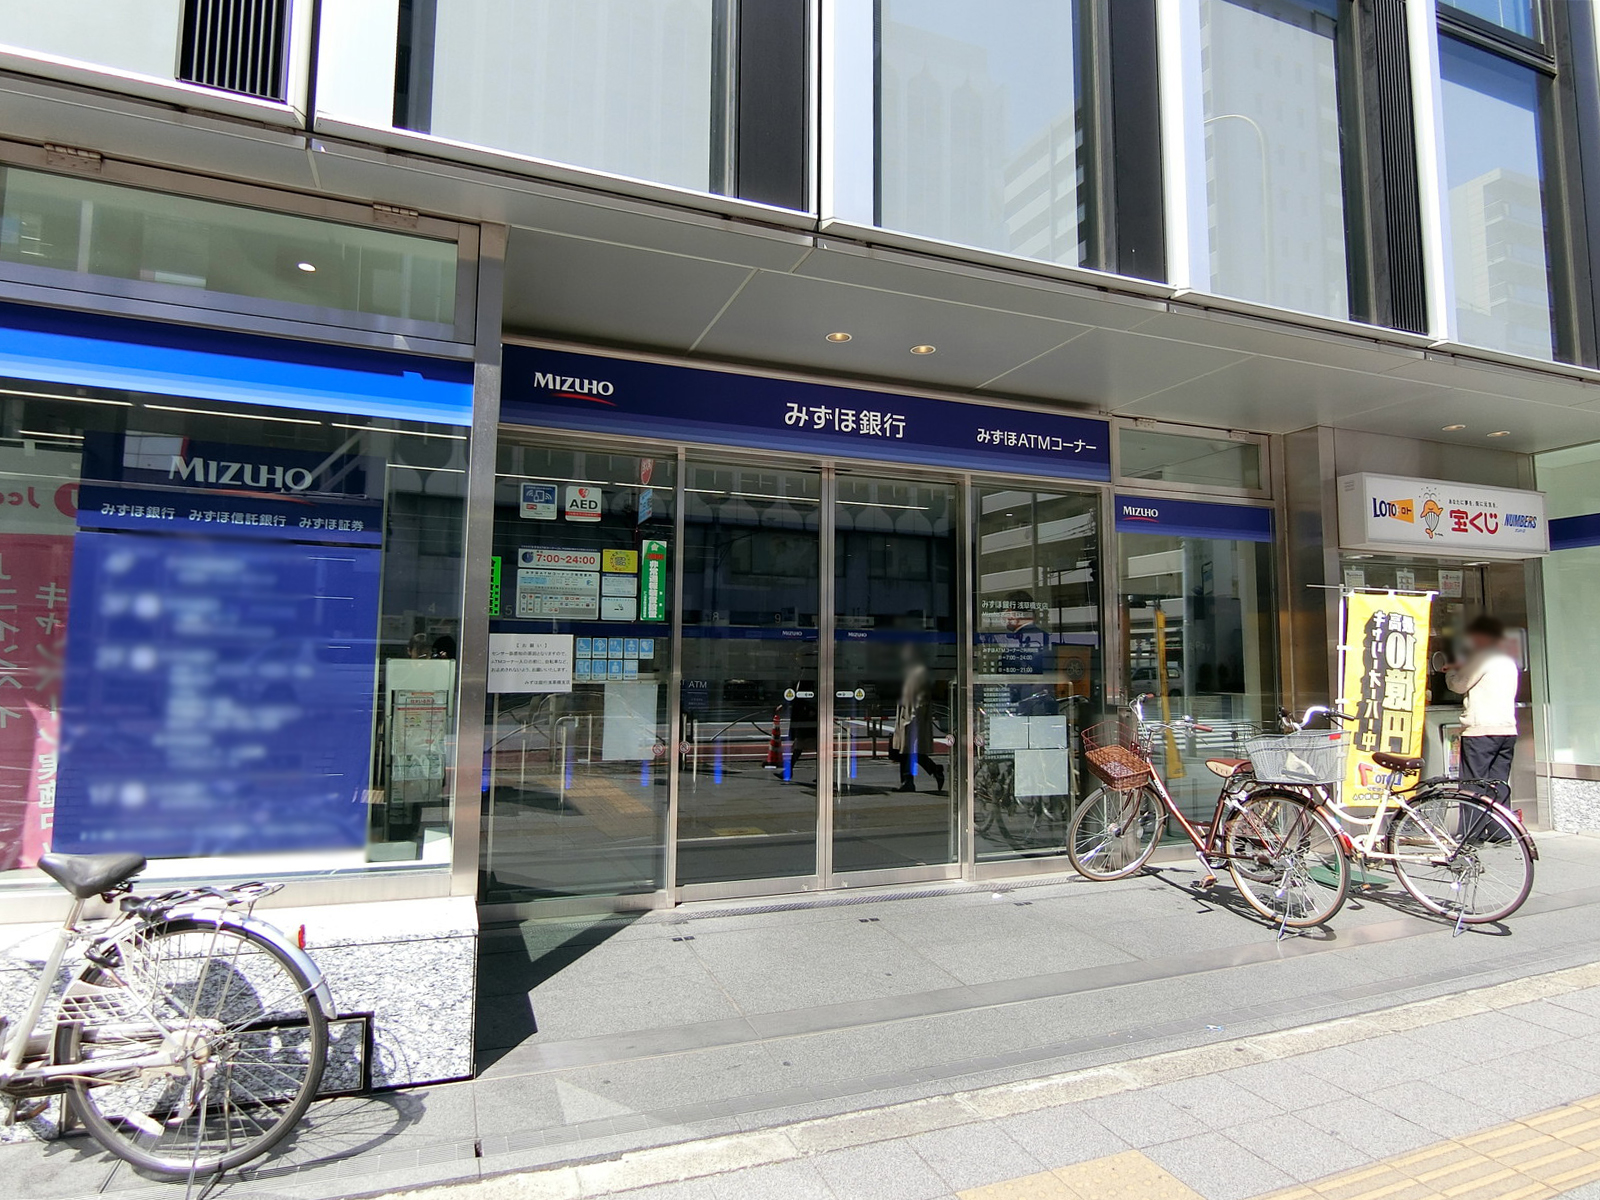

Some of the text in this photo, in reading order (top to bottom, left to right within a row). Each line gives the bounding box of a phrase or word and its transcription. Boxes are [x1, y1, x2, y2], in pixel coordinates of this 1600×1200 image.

[533, 371, 614, 396] MIZUHO
[784, 402, 906, 439] みずほ銀行
[976, 428, 1097, 453] みずほATMコーナー
[168, 455, 313, 490] MIZUHO
[569, 498, 598, 510] AED
[1122, 505, 1159, 518] MIZUHO
[1372, 497, 1397, 518] LOTO
[101, 503, 364, 532] みずほ銀行 みずほ信託銀行 みずほ証券
[1449, 508, 1499, 535] 宝くじ
[1503, 513, 1538, 529] NUMBERS
[774, 614, 781, 624] 9
[688, 680, 707, 689] ATM
